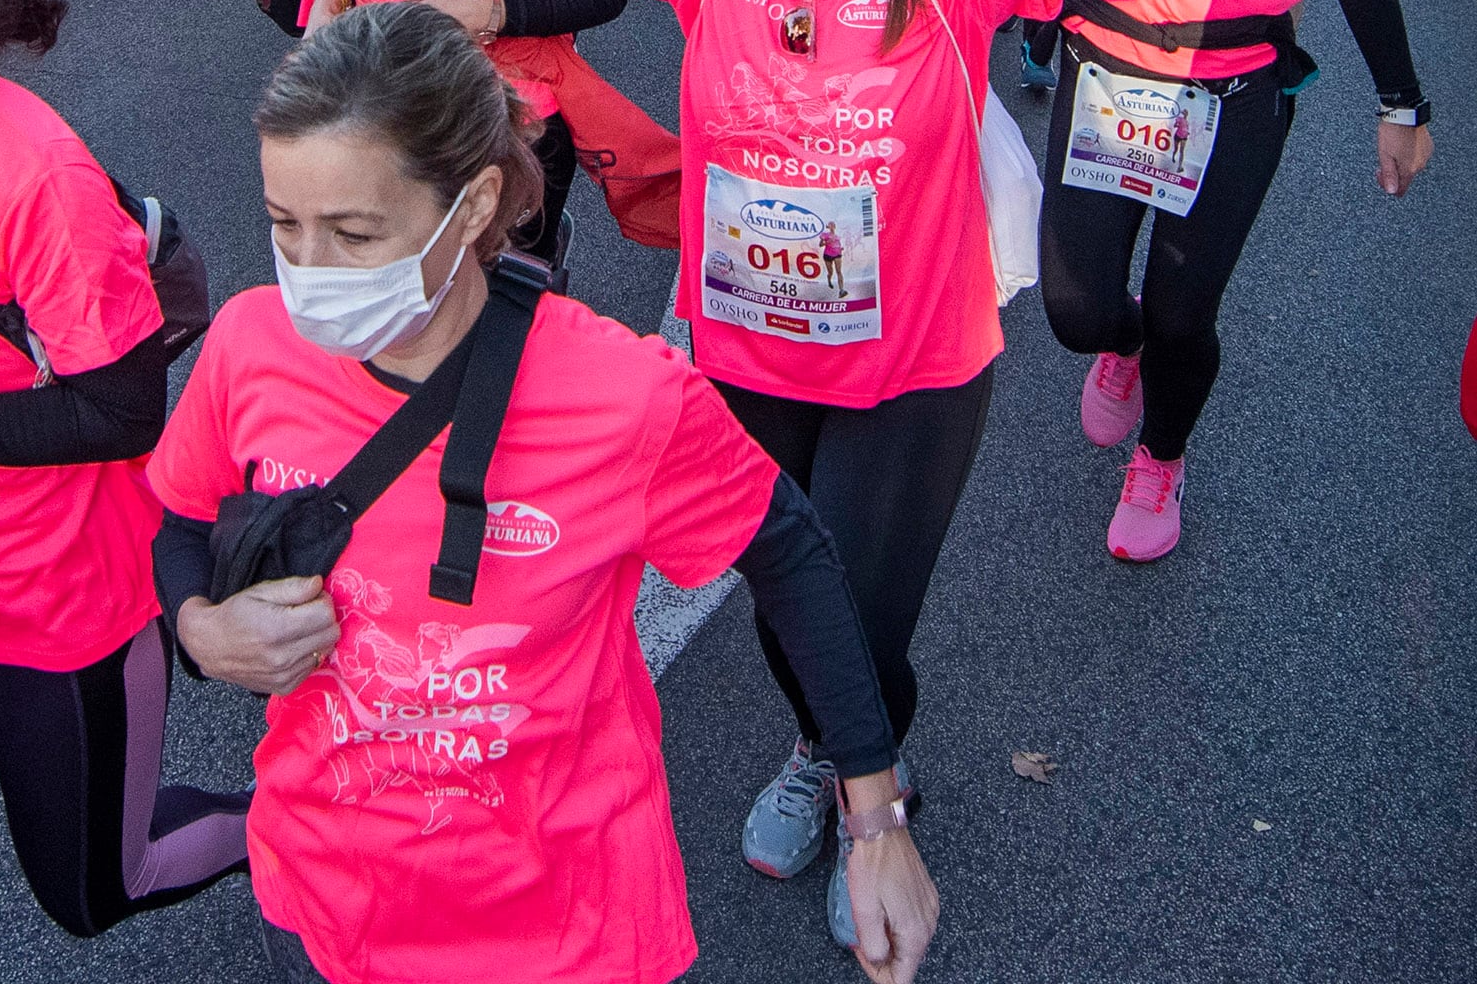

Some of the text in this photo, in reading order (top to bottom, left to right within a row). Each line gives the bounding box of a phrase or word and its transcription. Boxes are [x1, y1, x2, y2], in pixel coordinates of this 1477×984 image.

[1117, 95, 1176, 115] ASTURIANA
[835, 107, 894, 130] POR
[799, 135, 894, 158] TODAS
[1116, 119, 1173, 152] 016
[743, 149, 892, 186] NOSOTRAS
[1127, 147, 1155, 165] 2510
[1071, 166, 1116, 185] OYSHO
[1095, 154, 1182, 185] CARRERA DE LA MUJER
[746, 208, 818, 234] ASTURIANA
[747, 244, 821, 280] 016
[731, 286, 848, 313] CARRERA DE LA MUJER
[769, 280, 798, 297] 548
[709, 298, 759, 323] OYSHO
[834, 322, 870, 333] ZURICH
[426, 665, 509, 701] POR
[372, 699, 511, 724] TODAS
[326, 693, 509, 764] NOSOTRAS
